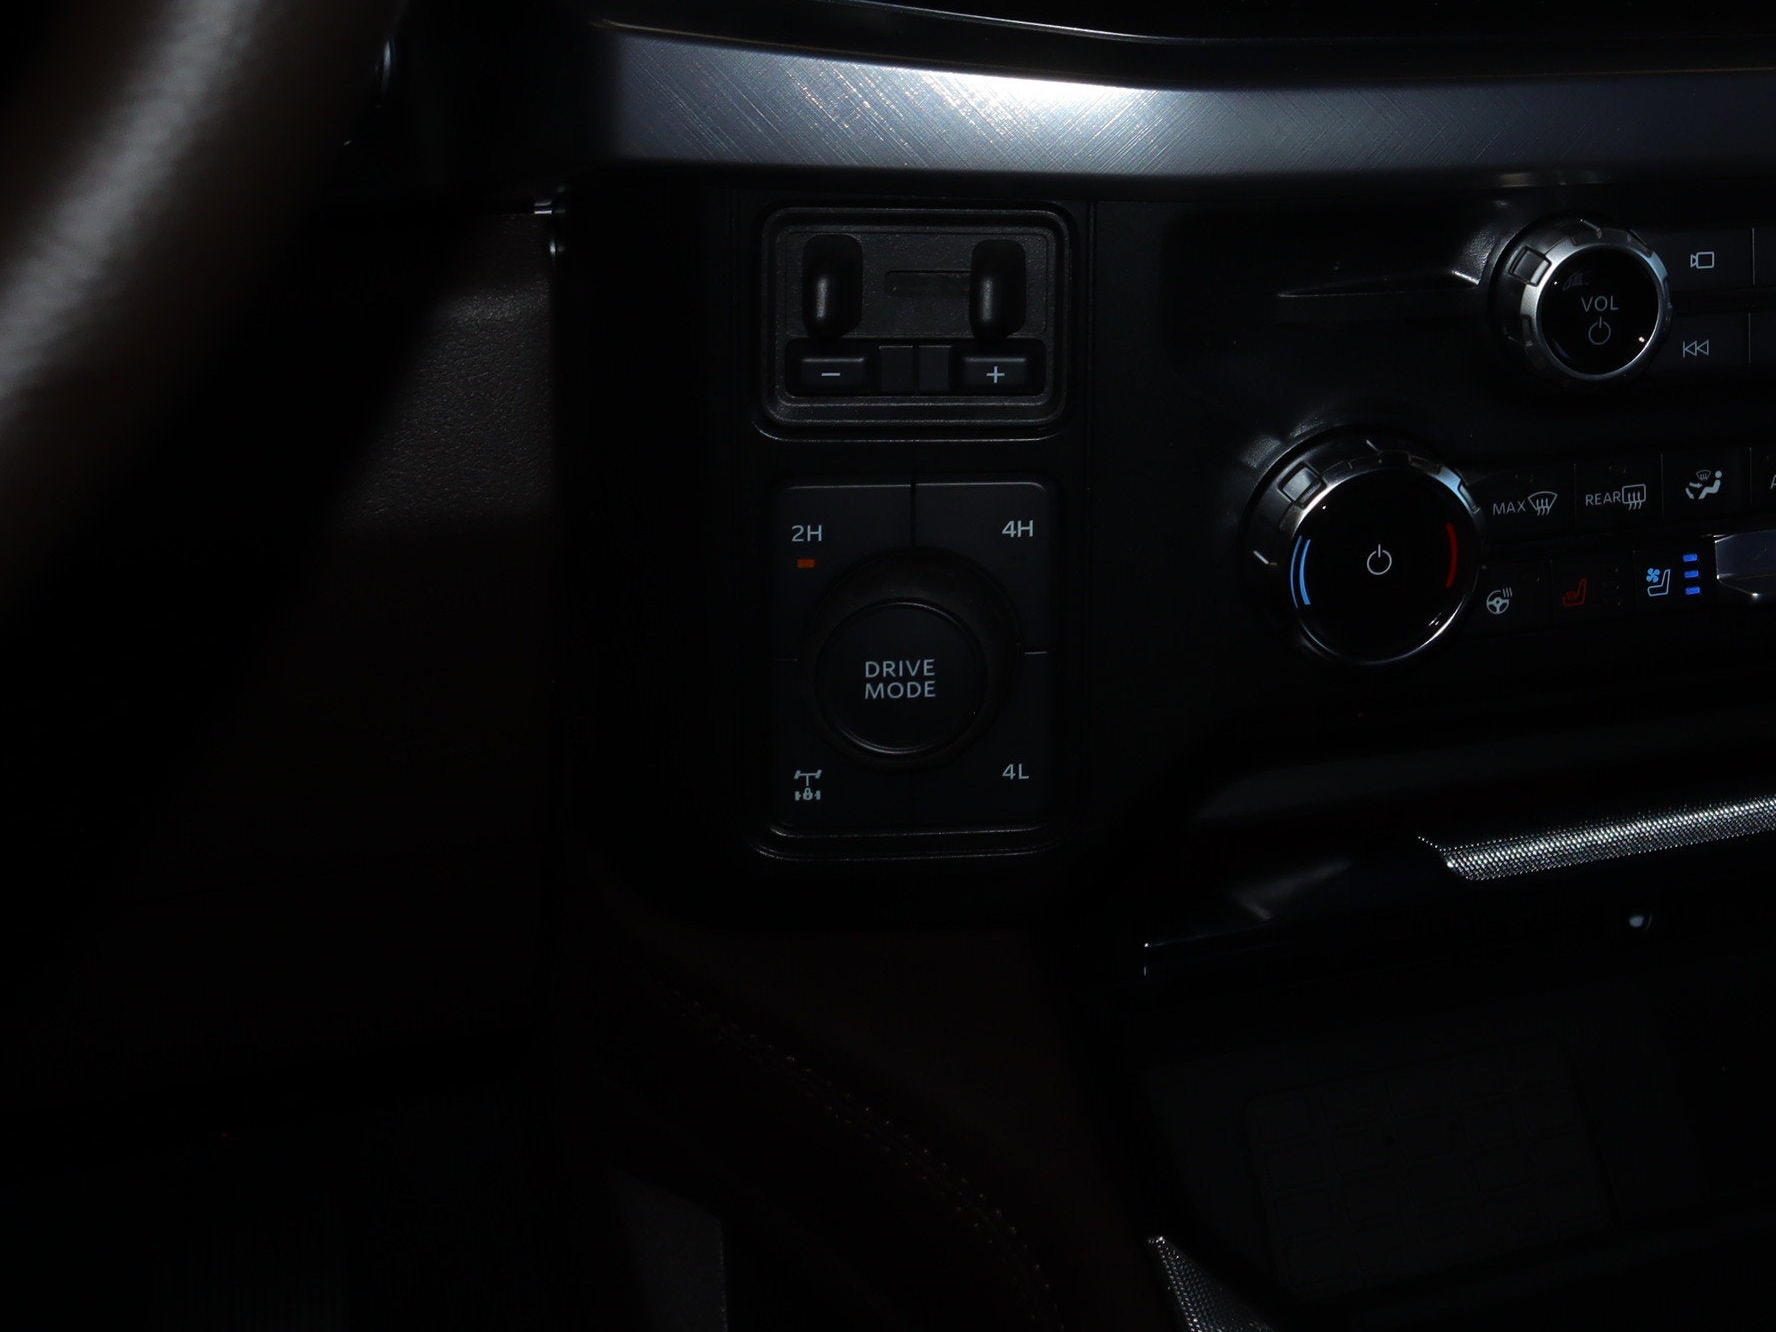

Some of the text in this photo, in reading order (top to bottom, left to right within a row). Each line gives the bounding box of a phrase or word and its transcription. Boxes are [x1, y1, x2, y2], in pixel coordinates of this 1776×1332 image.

[1580, 295, 1621, 313] VOL
[1492, 500, 1527, 516] MAX
[1585, 491, 1621, 507] REAR
[791, 524, 823, 543] 2H
[1002, 519, 1035, 539] 4H
[864, 658, 936, 678] DRIVE
[864, 680, 936, 700] MODE
[1002, 763, 1030, 781] 4L
